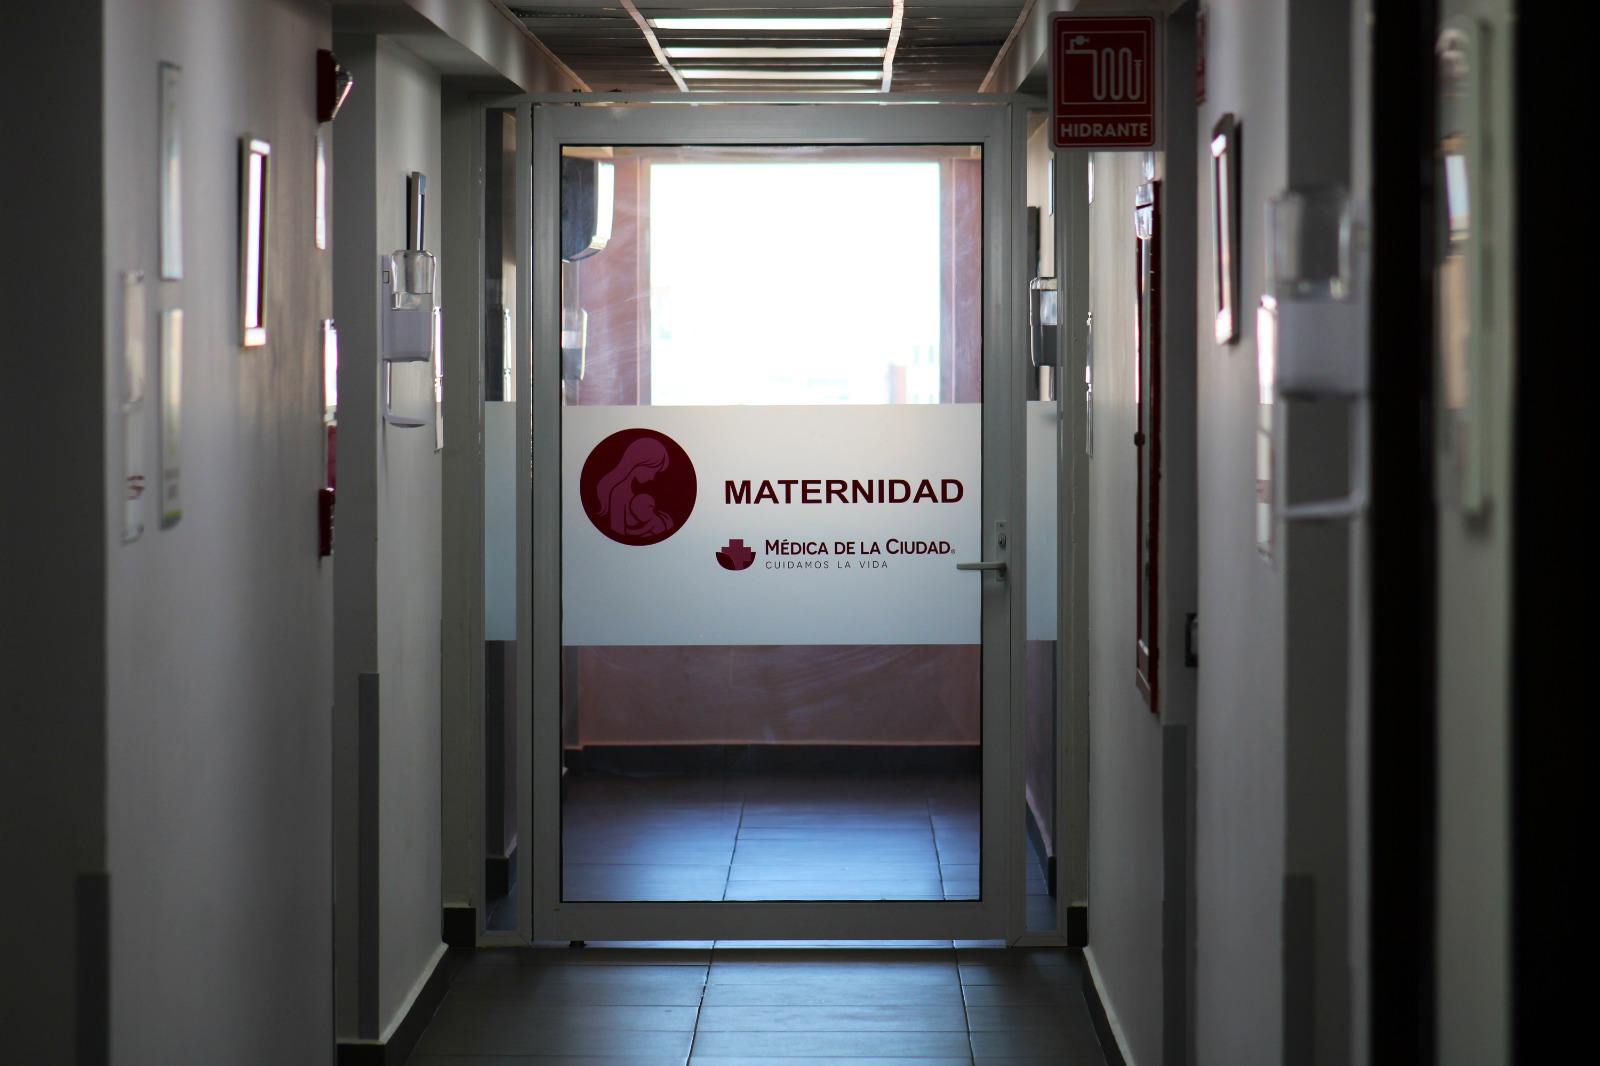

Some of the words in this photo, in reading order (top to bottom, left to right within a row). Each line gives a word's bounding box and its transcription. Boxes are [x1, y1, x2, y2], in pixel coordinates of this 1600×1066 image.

[1060, 123, 1149, 138] HIDRANTE
[724, 479, 964, 504] MATERNIDAD
[765, 539, 829, 555] MÉDICA
[834, 541, 855, 555] DE
[860, 541, 881, 555] LA
[765, 560, 829, 570] CUIDAMOS
[837, 560, 851, 569] LA
[859, 560, 888, 569] VIDA
